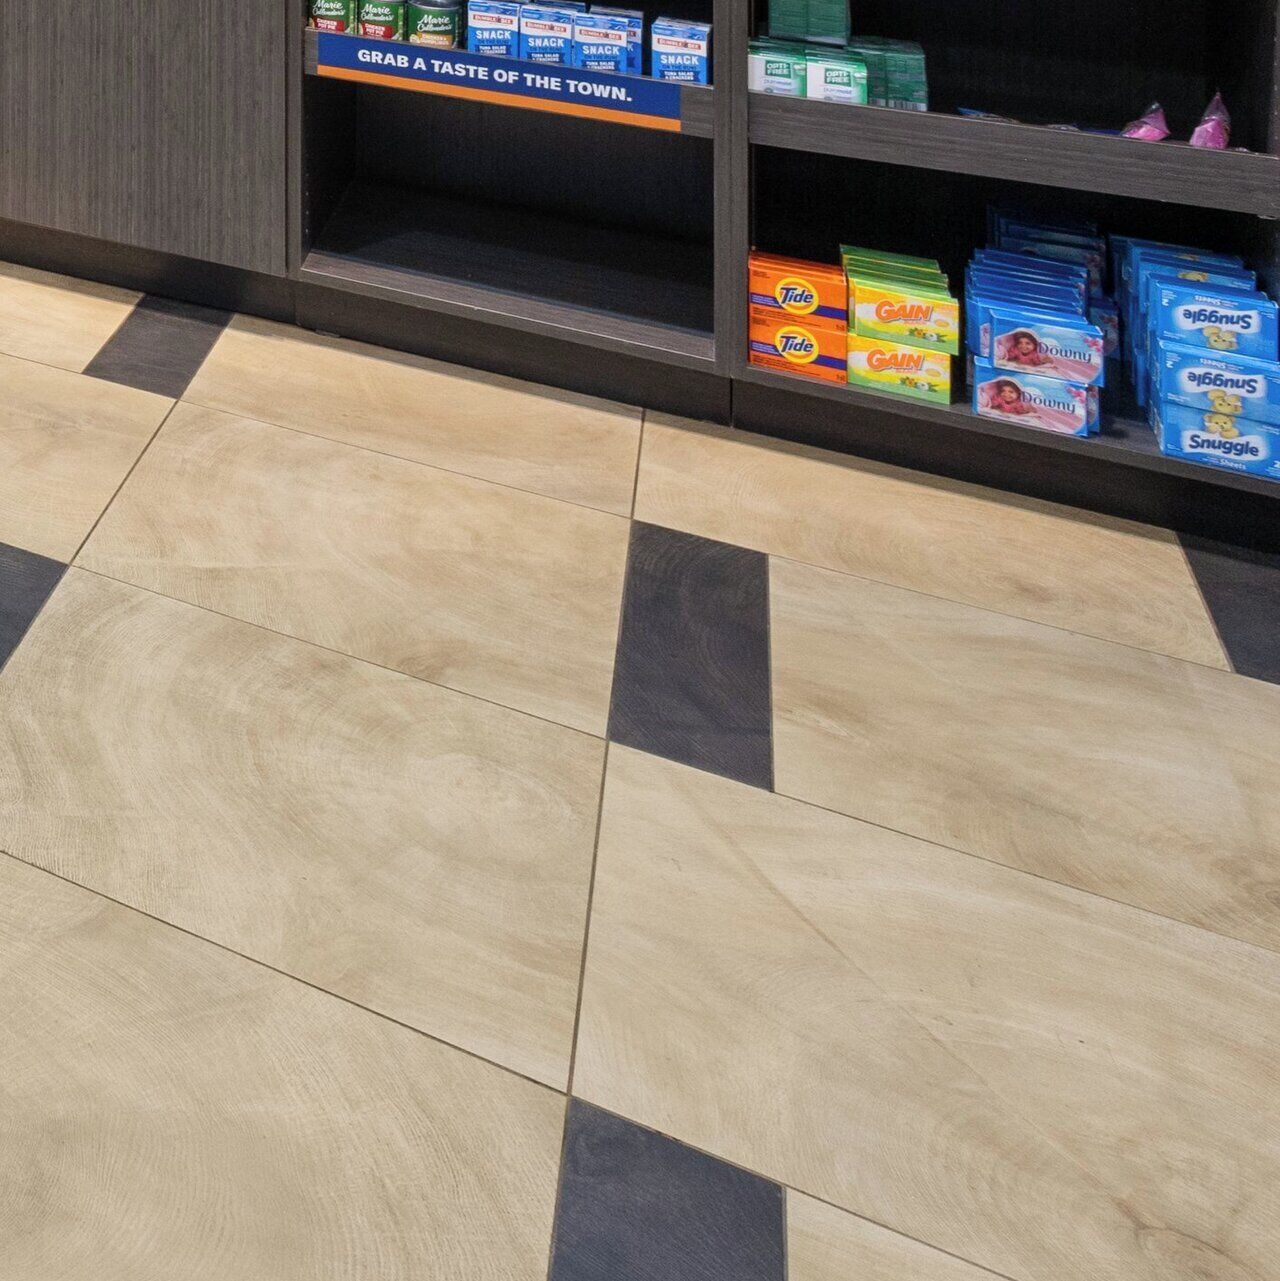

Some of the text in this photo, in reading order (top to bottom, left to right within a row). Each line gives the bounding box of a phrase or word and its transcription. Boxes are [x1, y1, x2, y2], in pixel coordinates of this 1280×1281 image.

[314, 0, 343, 9] Marie
[362, 4, 392, 14] Marie
[418, 14, 450, 24] Marie
[476, 30, 511, 39] SNACK
[528, 38, 564, 47] SNACK
[582, 46, 619, 55] SNACK
[661, 55, 698, 64] SNACK
[358, 50, 632, 101] GRAB A TASTE OF THE TOWN.
[780, 287, 814, 303] Tide
[876, 300, 933, 322] GAIN
[1183, 308, 1252, 330] Snuggle
[780, 335, 814, 352] Tide
[1038, 341, 1091, 363] Downy
[867, 349, 925, 371] GAIN
[1188, 371, 1258, 394] Snuggle
[1022, 391, 1075, 414] Downy
[1189, 434, 1259, 457] Snuggle
